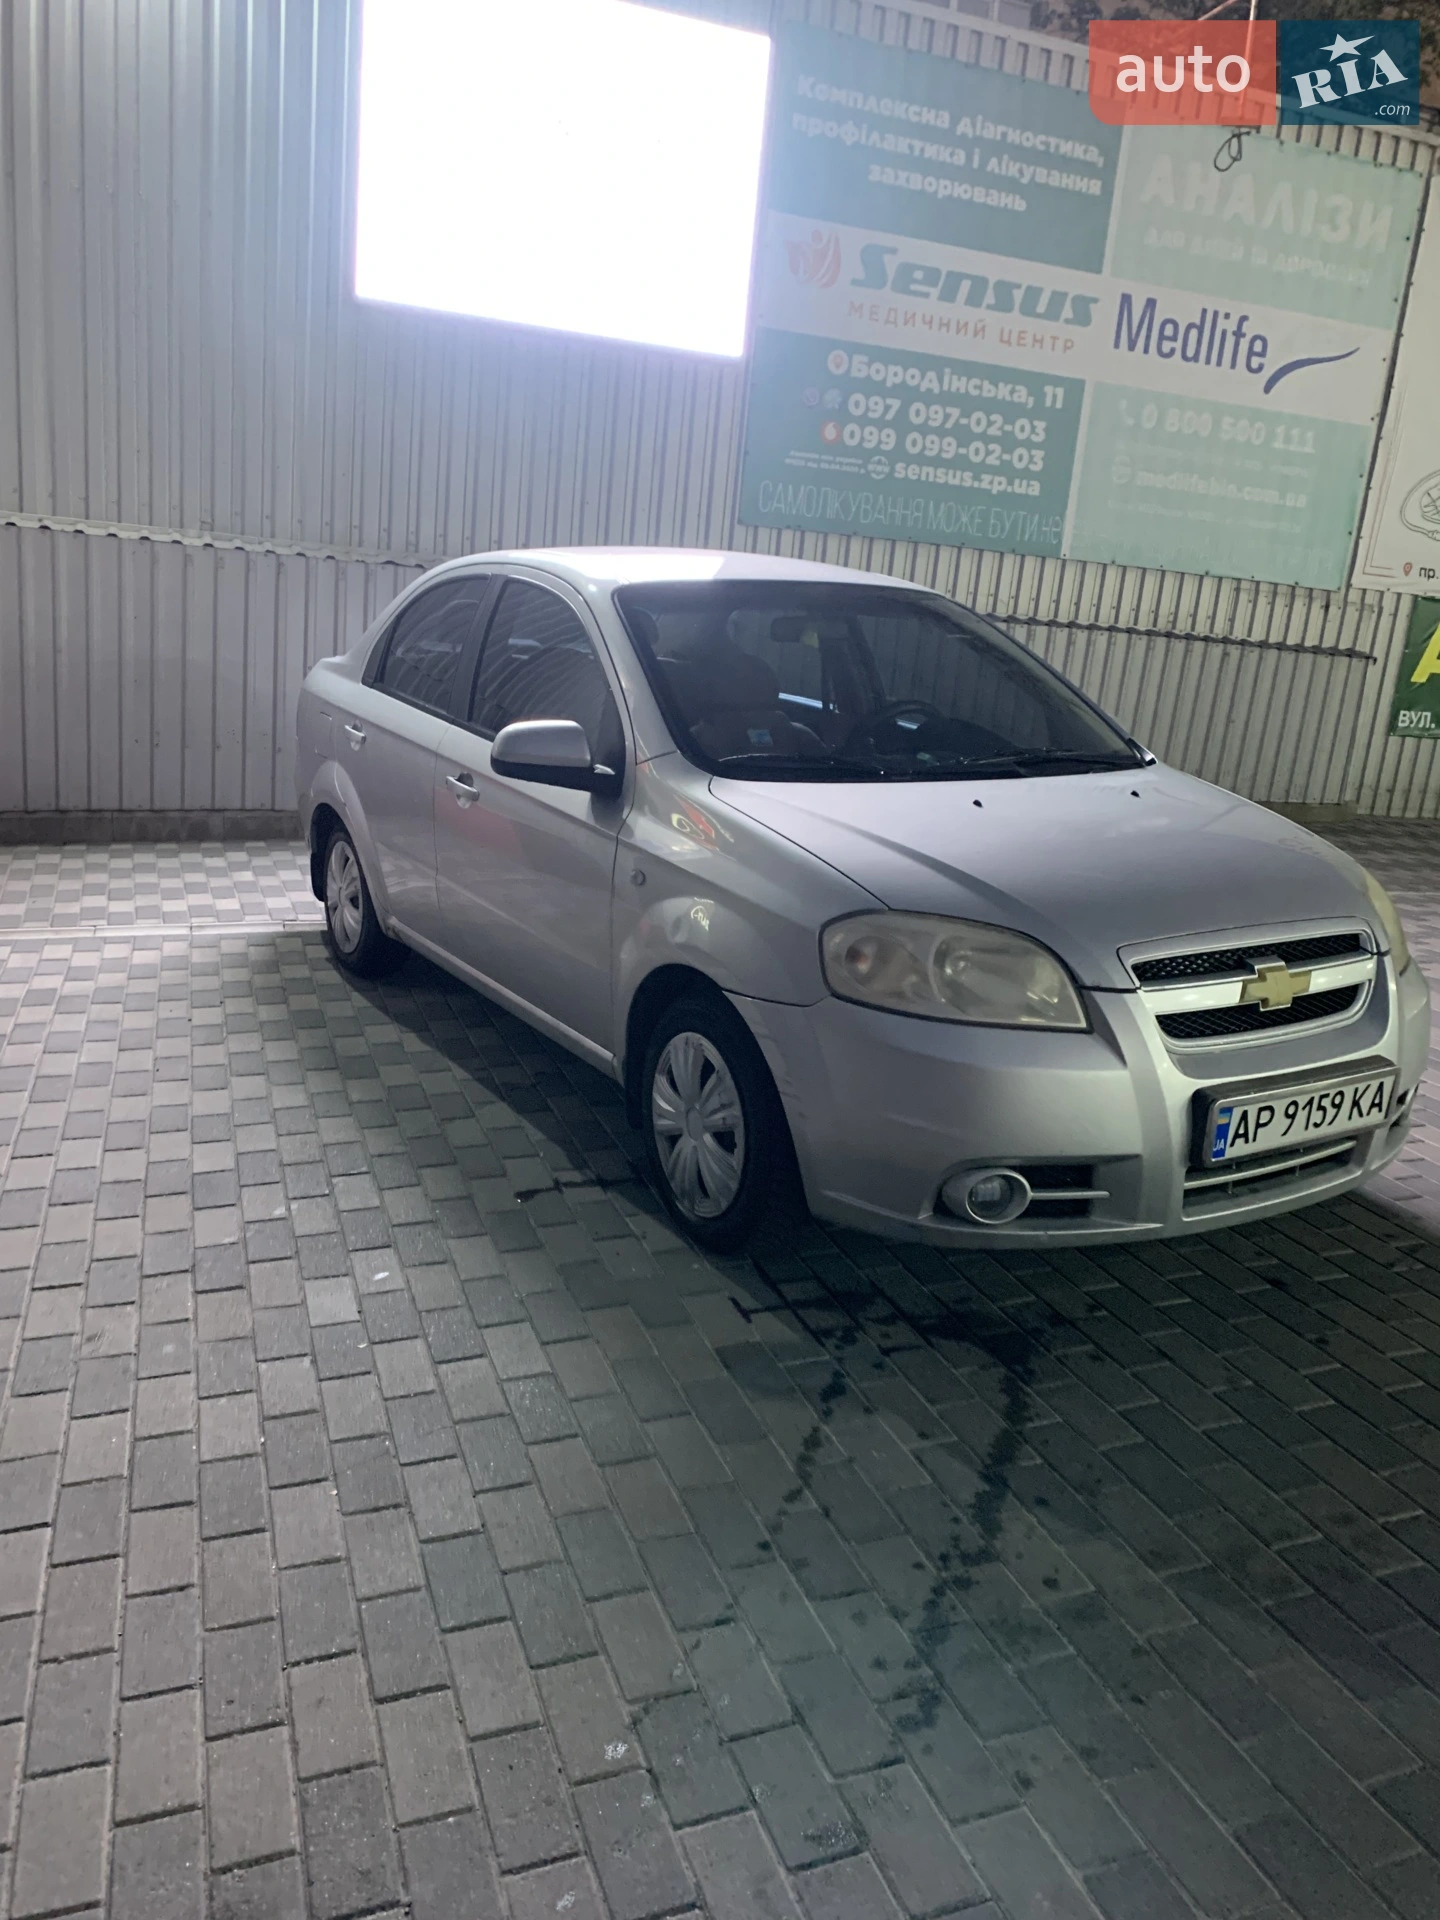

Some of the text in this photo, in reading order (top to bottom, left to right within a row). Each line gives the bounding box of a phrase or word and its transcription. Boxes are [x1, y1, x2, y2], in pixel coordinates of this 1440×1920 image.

[797, 74, 1104, 167] Комплексна діагностика,
[792, 111, 1103, 196] профілактика і лікування
[868, 163, 1028, 212] захворювань
[1140, 153, 1394, 254] АНАЛІЗИ
[850, 243, 1100, 328] Sensus
[848, 301, 1075, 354] МЕДИЧНИЙ ЦЕНТР
[1113, 292, 1269, 375] Medlife
[851, 354, 1065, 409] Бородінська, 11
[847, 392, 1047, 443] 097 097-02-03
[842, 423, 897, 451] 099
[905, 432, 1045, 472] 099-02-03
[894, 462, 1041, 496] sensus.zp.ua
[758, 480, 923, 529] САМОЛІКУВАННЯ
[926, 502, 986, 539] МОЖЕ
[988, 508, 1039, 543] БУТИ
[1418, 566, 1440, 581] пр.
[1398, 710, 1436, 729] ВУЛ.
[1229, 1081, 1386, 1148] AP 9159 KA
